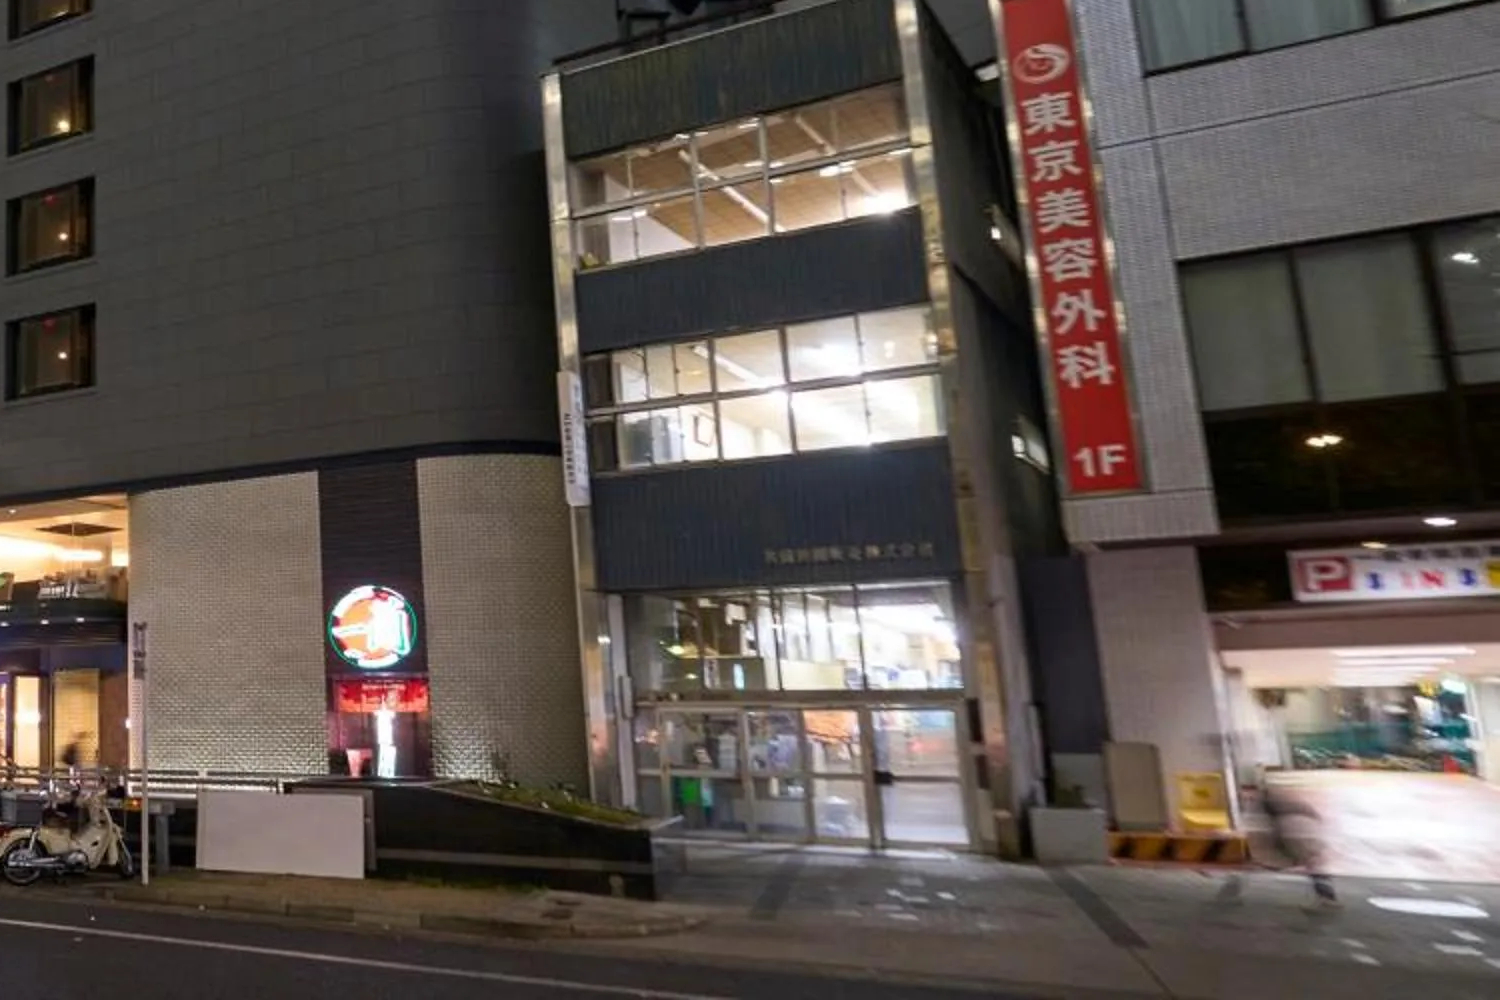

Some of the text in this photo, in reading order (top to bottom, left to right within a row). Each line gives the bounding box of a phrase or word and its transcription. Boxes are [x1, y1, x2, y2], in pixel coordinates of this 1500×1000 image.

[1021, 91, 1117, 388] 東京美容外科
[1073, 443, 1128, 478] 1F
